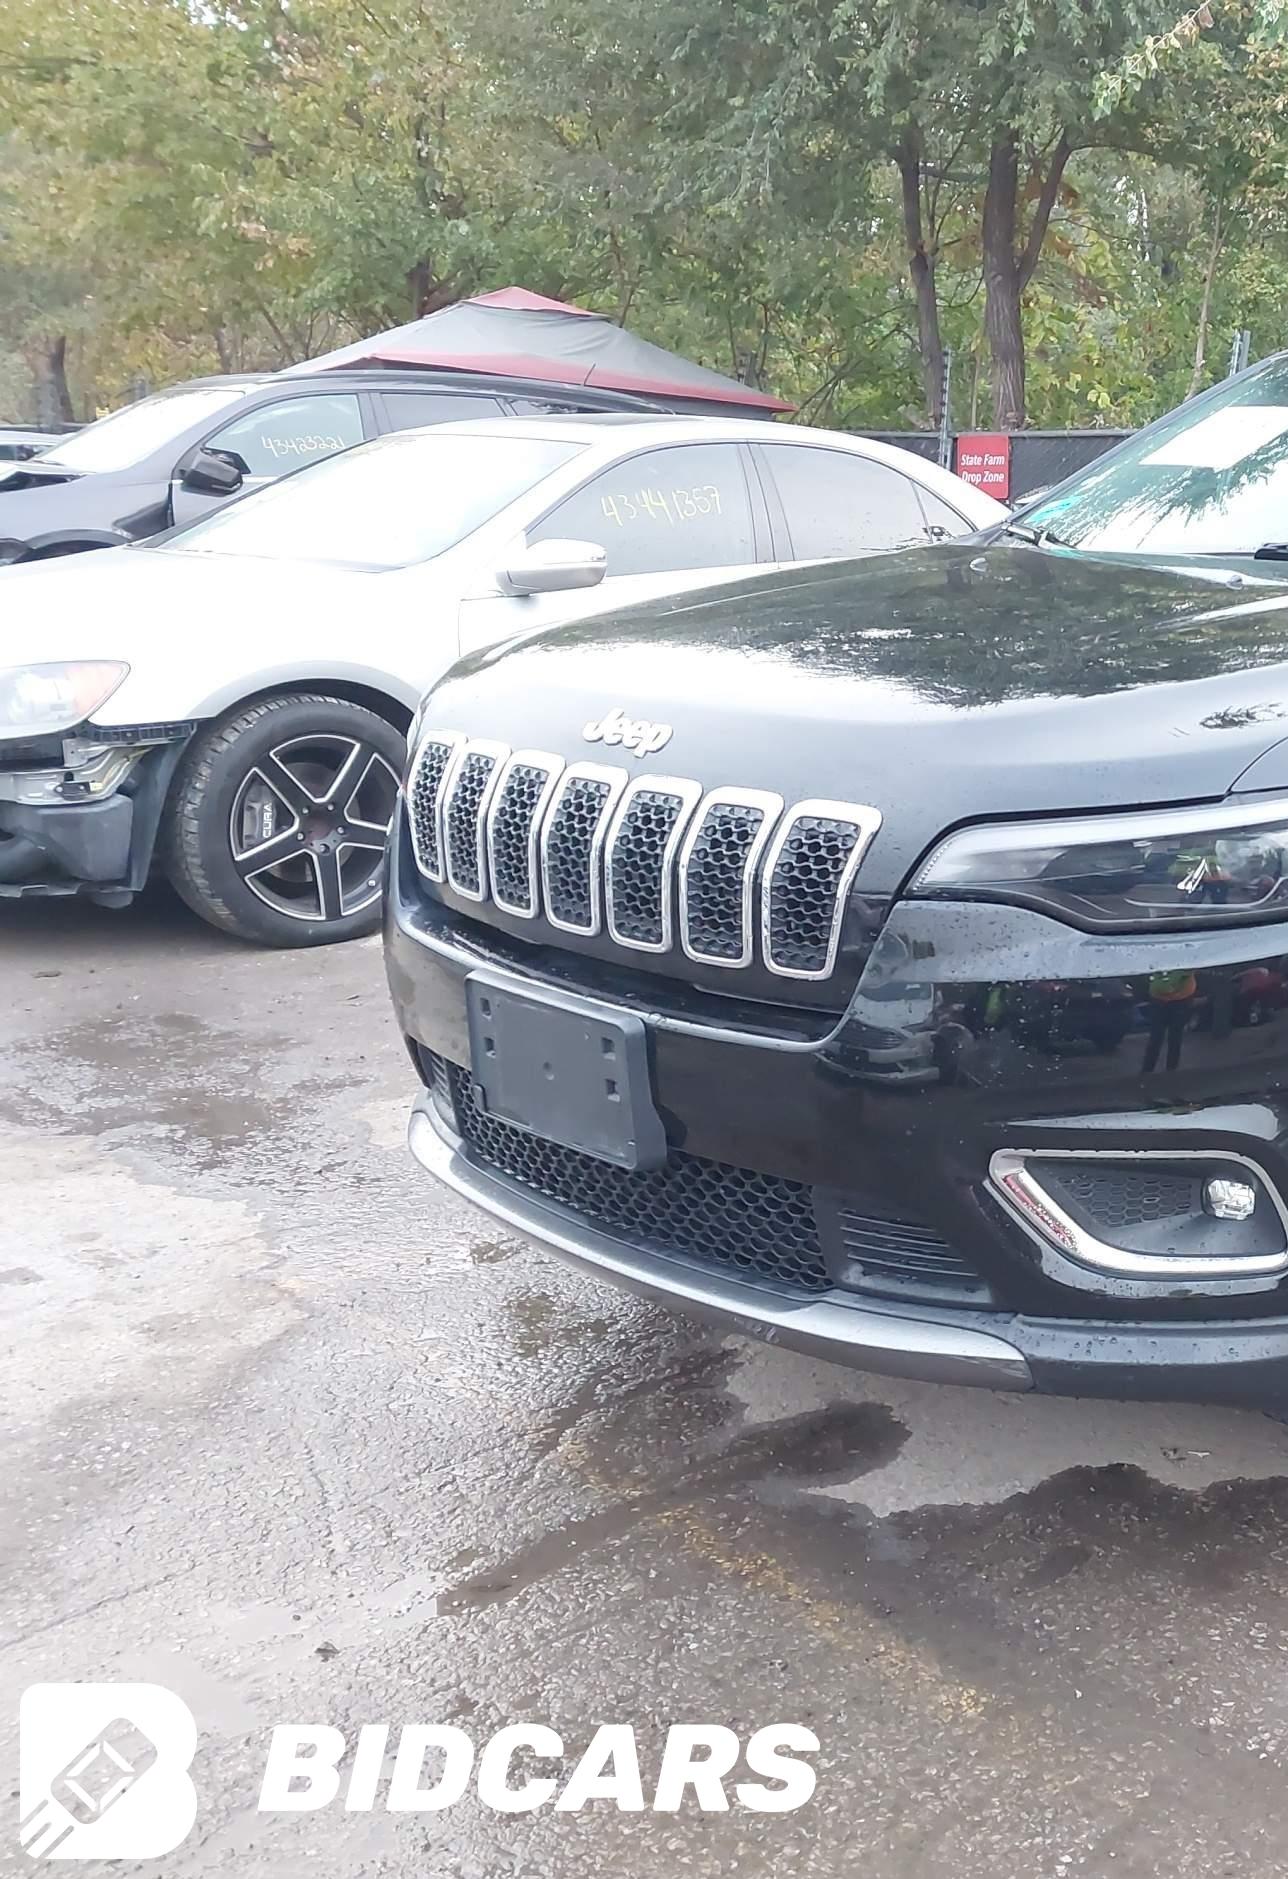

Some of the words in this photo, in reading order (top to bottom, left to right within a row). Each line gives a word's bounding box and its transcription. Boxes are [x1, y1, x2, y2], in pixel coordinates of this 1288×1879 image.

[261, 435, 346, 458] 43423221
[960, 453, 983, 466] State
[983, 453, 1005, 466] Farm
[961, 470, 981, 486] Drop
[982, 470, 1005, 483] Zone
[600, 485, 722, 528] 43441357
[582, 706, 674, 759] Jeep
[262, 801, 272, 838] CURA
